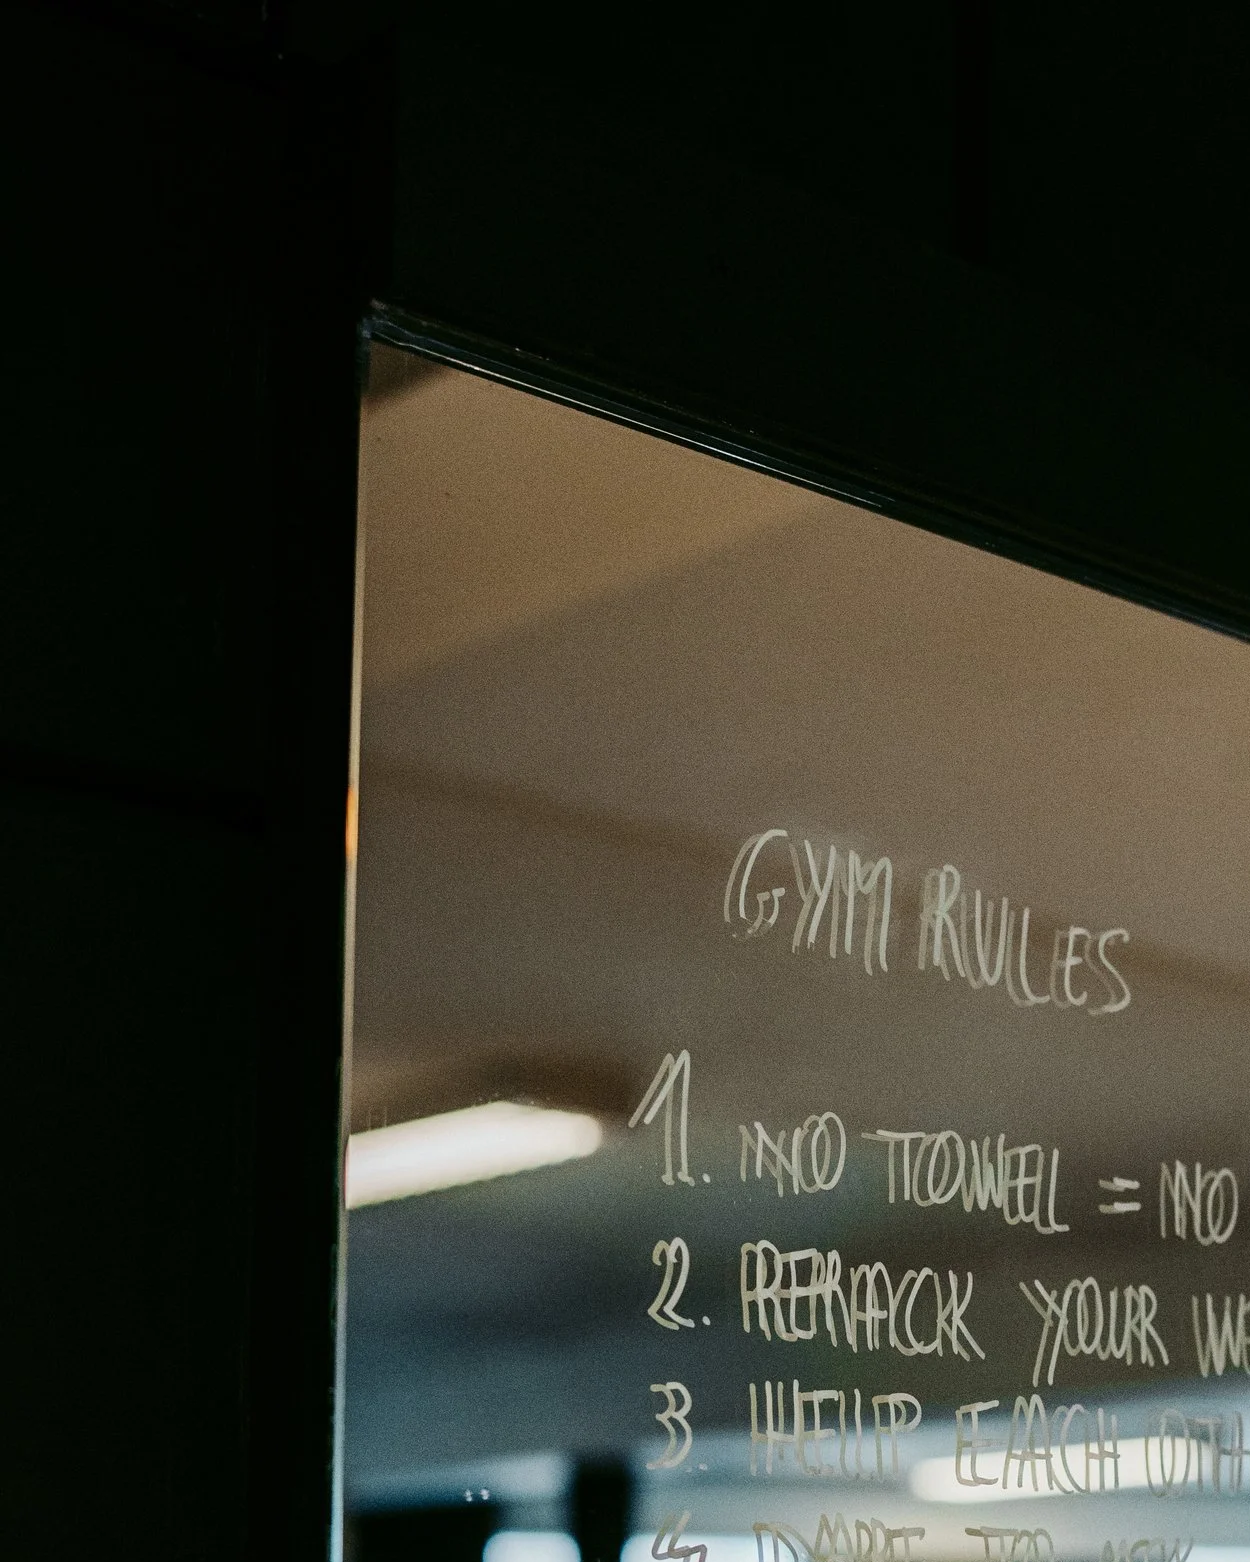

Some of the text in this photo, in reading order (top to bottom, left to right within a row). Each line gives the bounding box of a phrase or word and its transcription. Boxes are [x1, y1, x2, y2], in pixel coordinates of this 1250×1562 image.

[724, 829, 1131, 1014] GYM RULES
[628, 1049, 711, 1186] 1.
[739, 1112, 846, 1197] NO
[862, 1128, 1069, 1232] TOWEL
[1160, 1160, 1239, 1245] NO
[647, 1237, 711, 1330] 2.
[740, 1239, 986, 1361] RERACK
[1019, 1276, 1169, 1388] YOUR
[645, 1381, 707, 1470] 3.
[749, 1379, 922, 1481] HELP
[955, 1394, 1120, 1494] EACH
